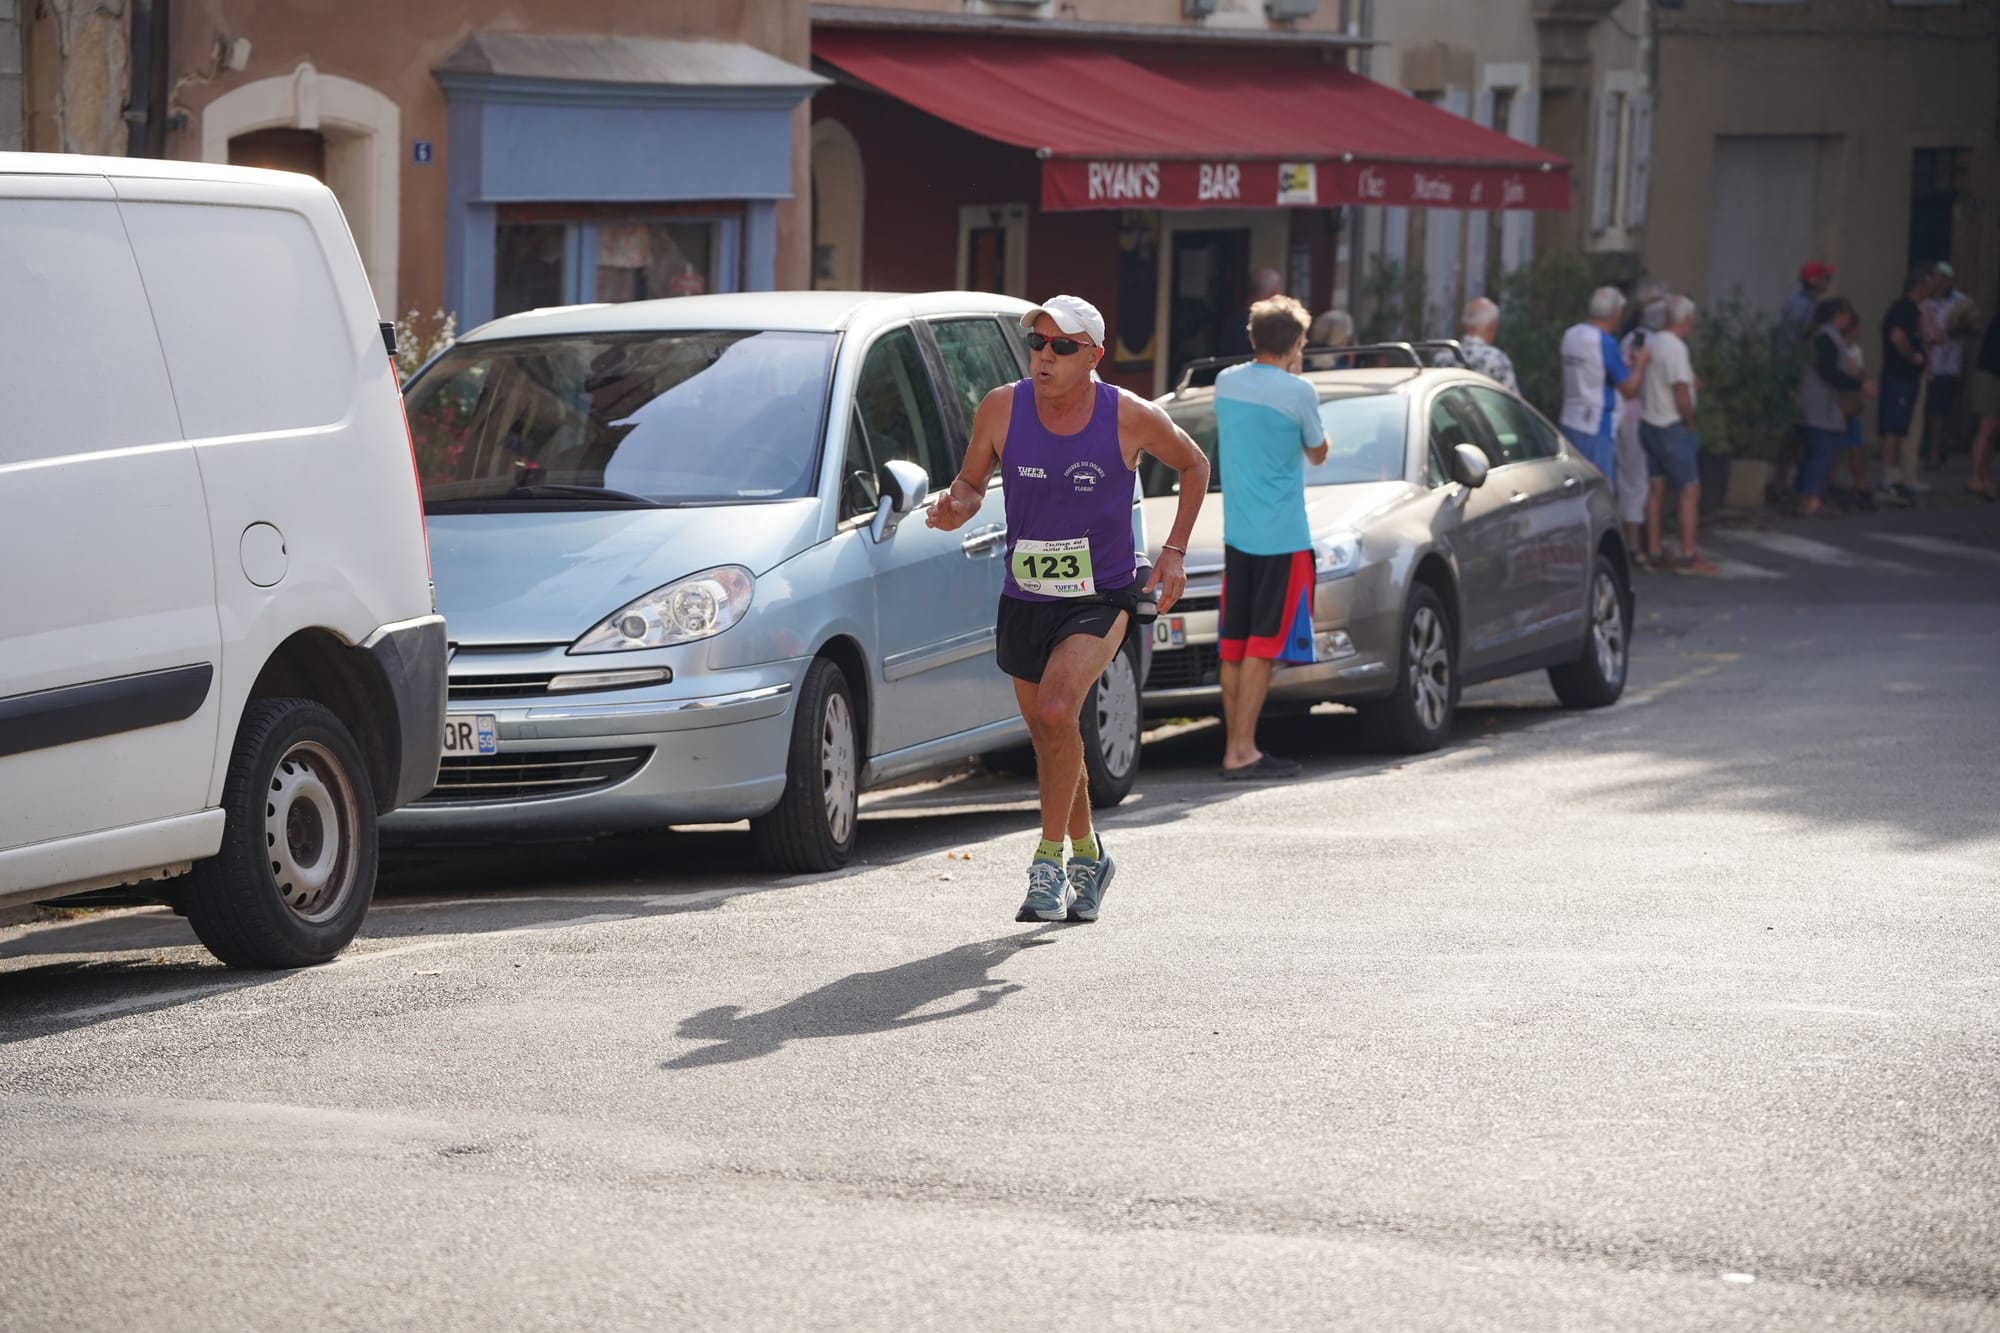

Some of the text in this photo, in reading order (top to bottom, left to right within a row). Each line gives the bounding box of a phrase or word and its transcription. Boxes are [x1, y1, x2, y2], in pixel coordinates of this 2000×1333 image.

[1089, 161, 1160, 199] RYAN'S
[1198, 164, 1241, 199] BAR
[1022, 555, 1080, 578] 123
[480, 734, 494, 748] 59
